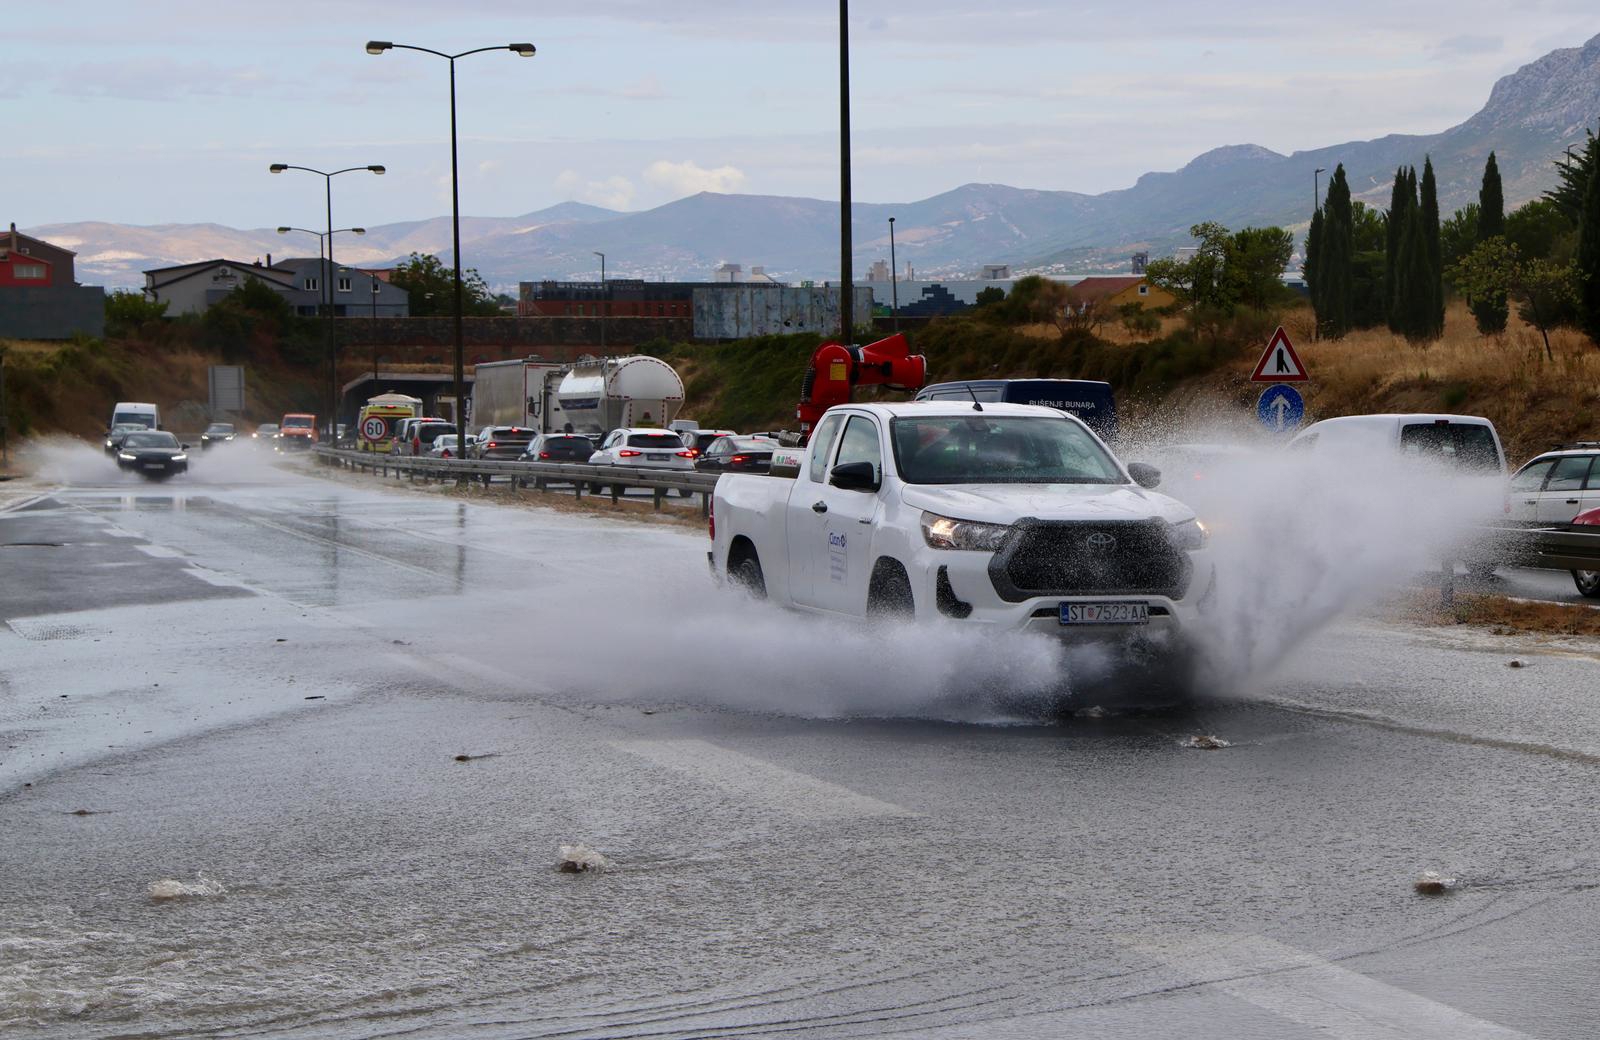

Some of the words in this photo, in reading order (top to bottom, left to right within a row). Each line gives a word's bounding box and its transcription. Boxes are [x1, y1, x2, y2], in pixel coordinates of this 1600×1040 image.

[1029, 399, 1063, 407] BUŠENJE
[367, 422, 382, 436] 60
[1070, 605, 1086, 620] ST
